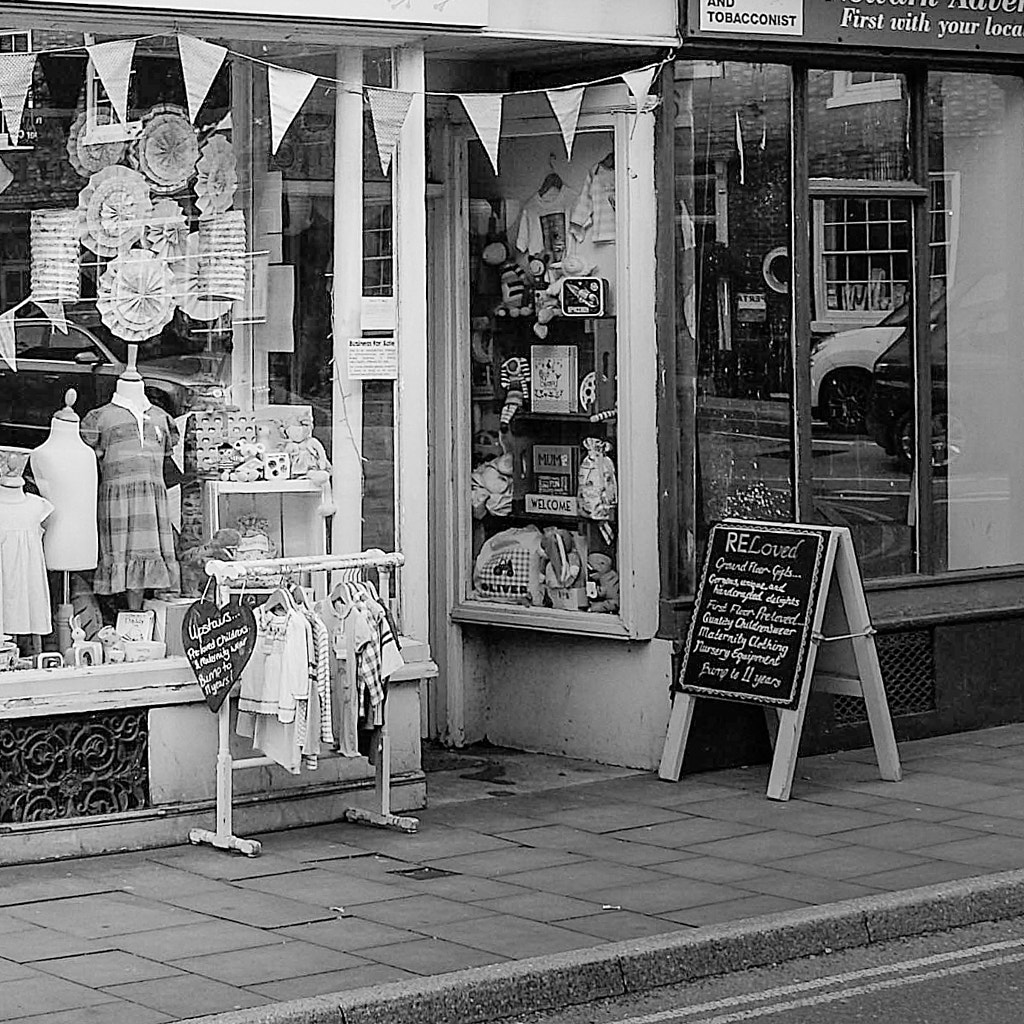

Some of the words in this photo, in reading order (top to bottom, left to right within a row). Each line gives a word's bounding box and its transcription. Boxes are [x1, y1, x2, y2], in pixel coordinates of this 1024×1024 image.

[706, 11, 797, 27] TOBACCONIST
[840, 7, 885, 30] First
[890, 11, 931, 33] with
[938, 19, 980, 39] your
[531, 498, 571, 512] WELCOME
[716, 557, 749, 573] Ground
[748, 561, 771, 575] Floor
[768, 582, 787, 593] and
[707, 599, 728, 613] First
[729, 604, 756, 616] Floor
[765, 593, 800, 607] delights
[702, 611, 734, 631] Quality
[698, 626, 747, 650] Maternity
[748, 635, 789, 658] Clothing
[693, 639, 731, 661] Nursery
[731, 650, 781, 666] Equipment
[198, 666, 222, 687] Bump
[222, 661, 232, 672] to
[698, 662, 729, 681] Bump
[730, 668, 740, 679] to
[752, 674, 782, 688] years
